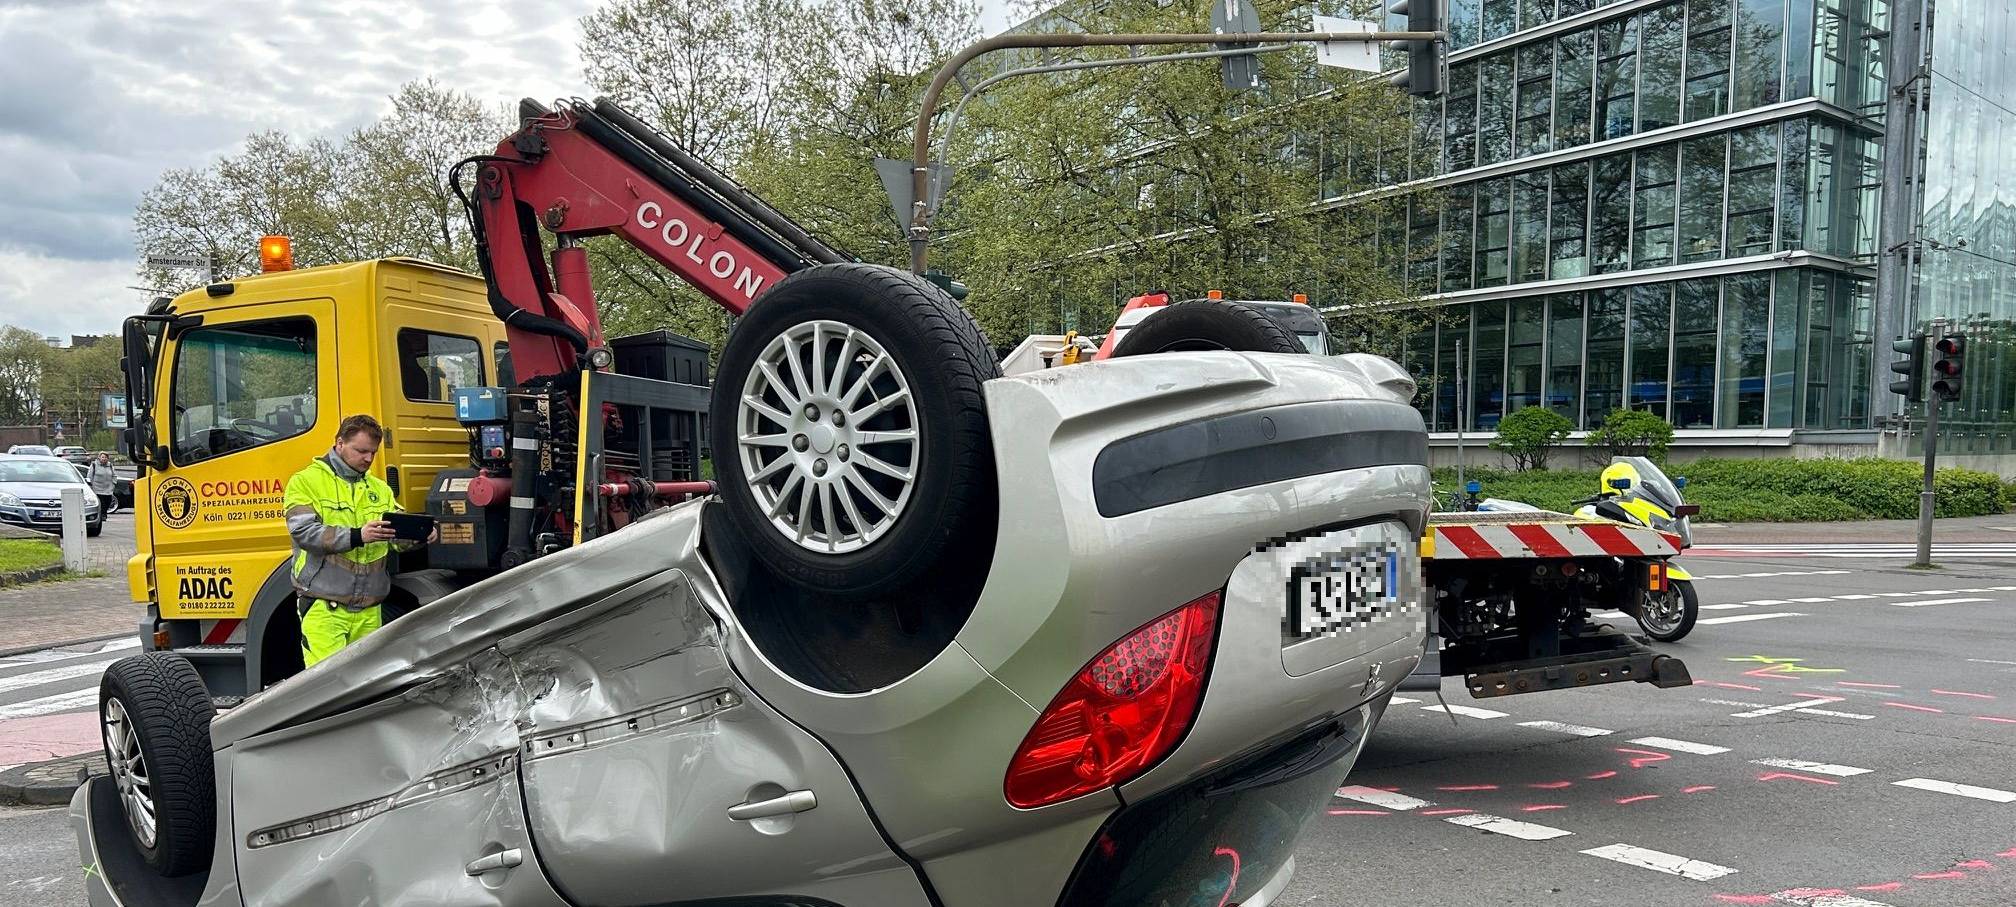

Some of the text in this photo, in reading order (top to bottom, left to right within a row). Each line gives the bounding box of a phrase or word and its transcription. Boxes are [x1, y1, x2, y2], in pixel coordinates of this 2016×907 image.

[636, 201, 764, 299] COLON
[148, 257, 194, 266] Amsterdamer
[158, 480, 192, 496] COLONIA
[201, 479, 283, 497] COLONIA
[202, 497, 285, 507] SPEZIALFAHRZEUGE
[157, 502, 197, 527] SPEZIALFAHRZEUGE
[203, 513, 223, 522] Köln
[227, 512, 247, 521] 0221
[253, 510, 264, 520] 95
[264, 510, 276, 519] 68
[176, 565, 232, 576] Im Auftrag des
[178, 576, 234, 600] ADAC
